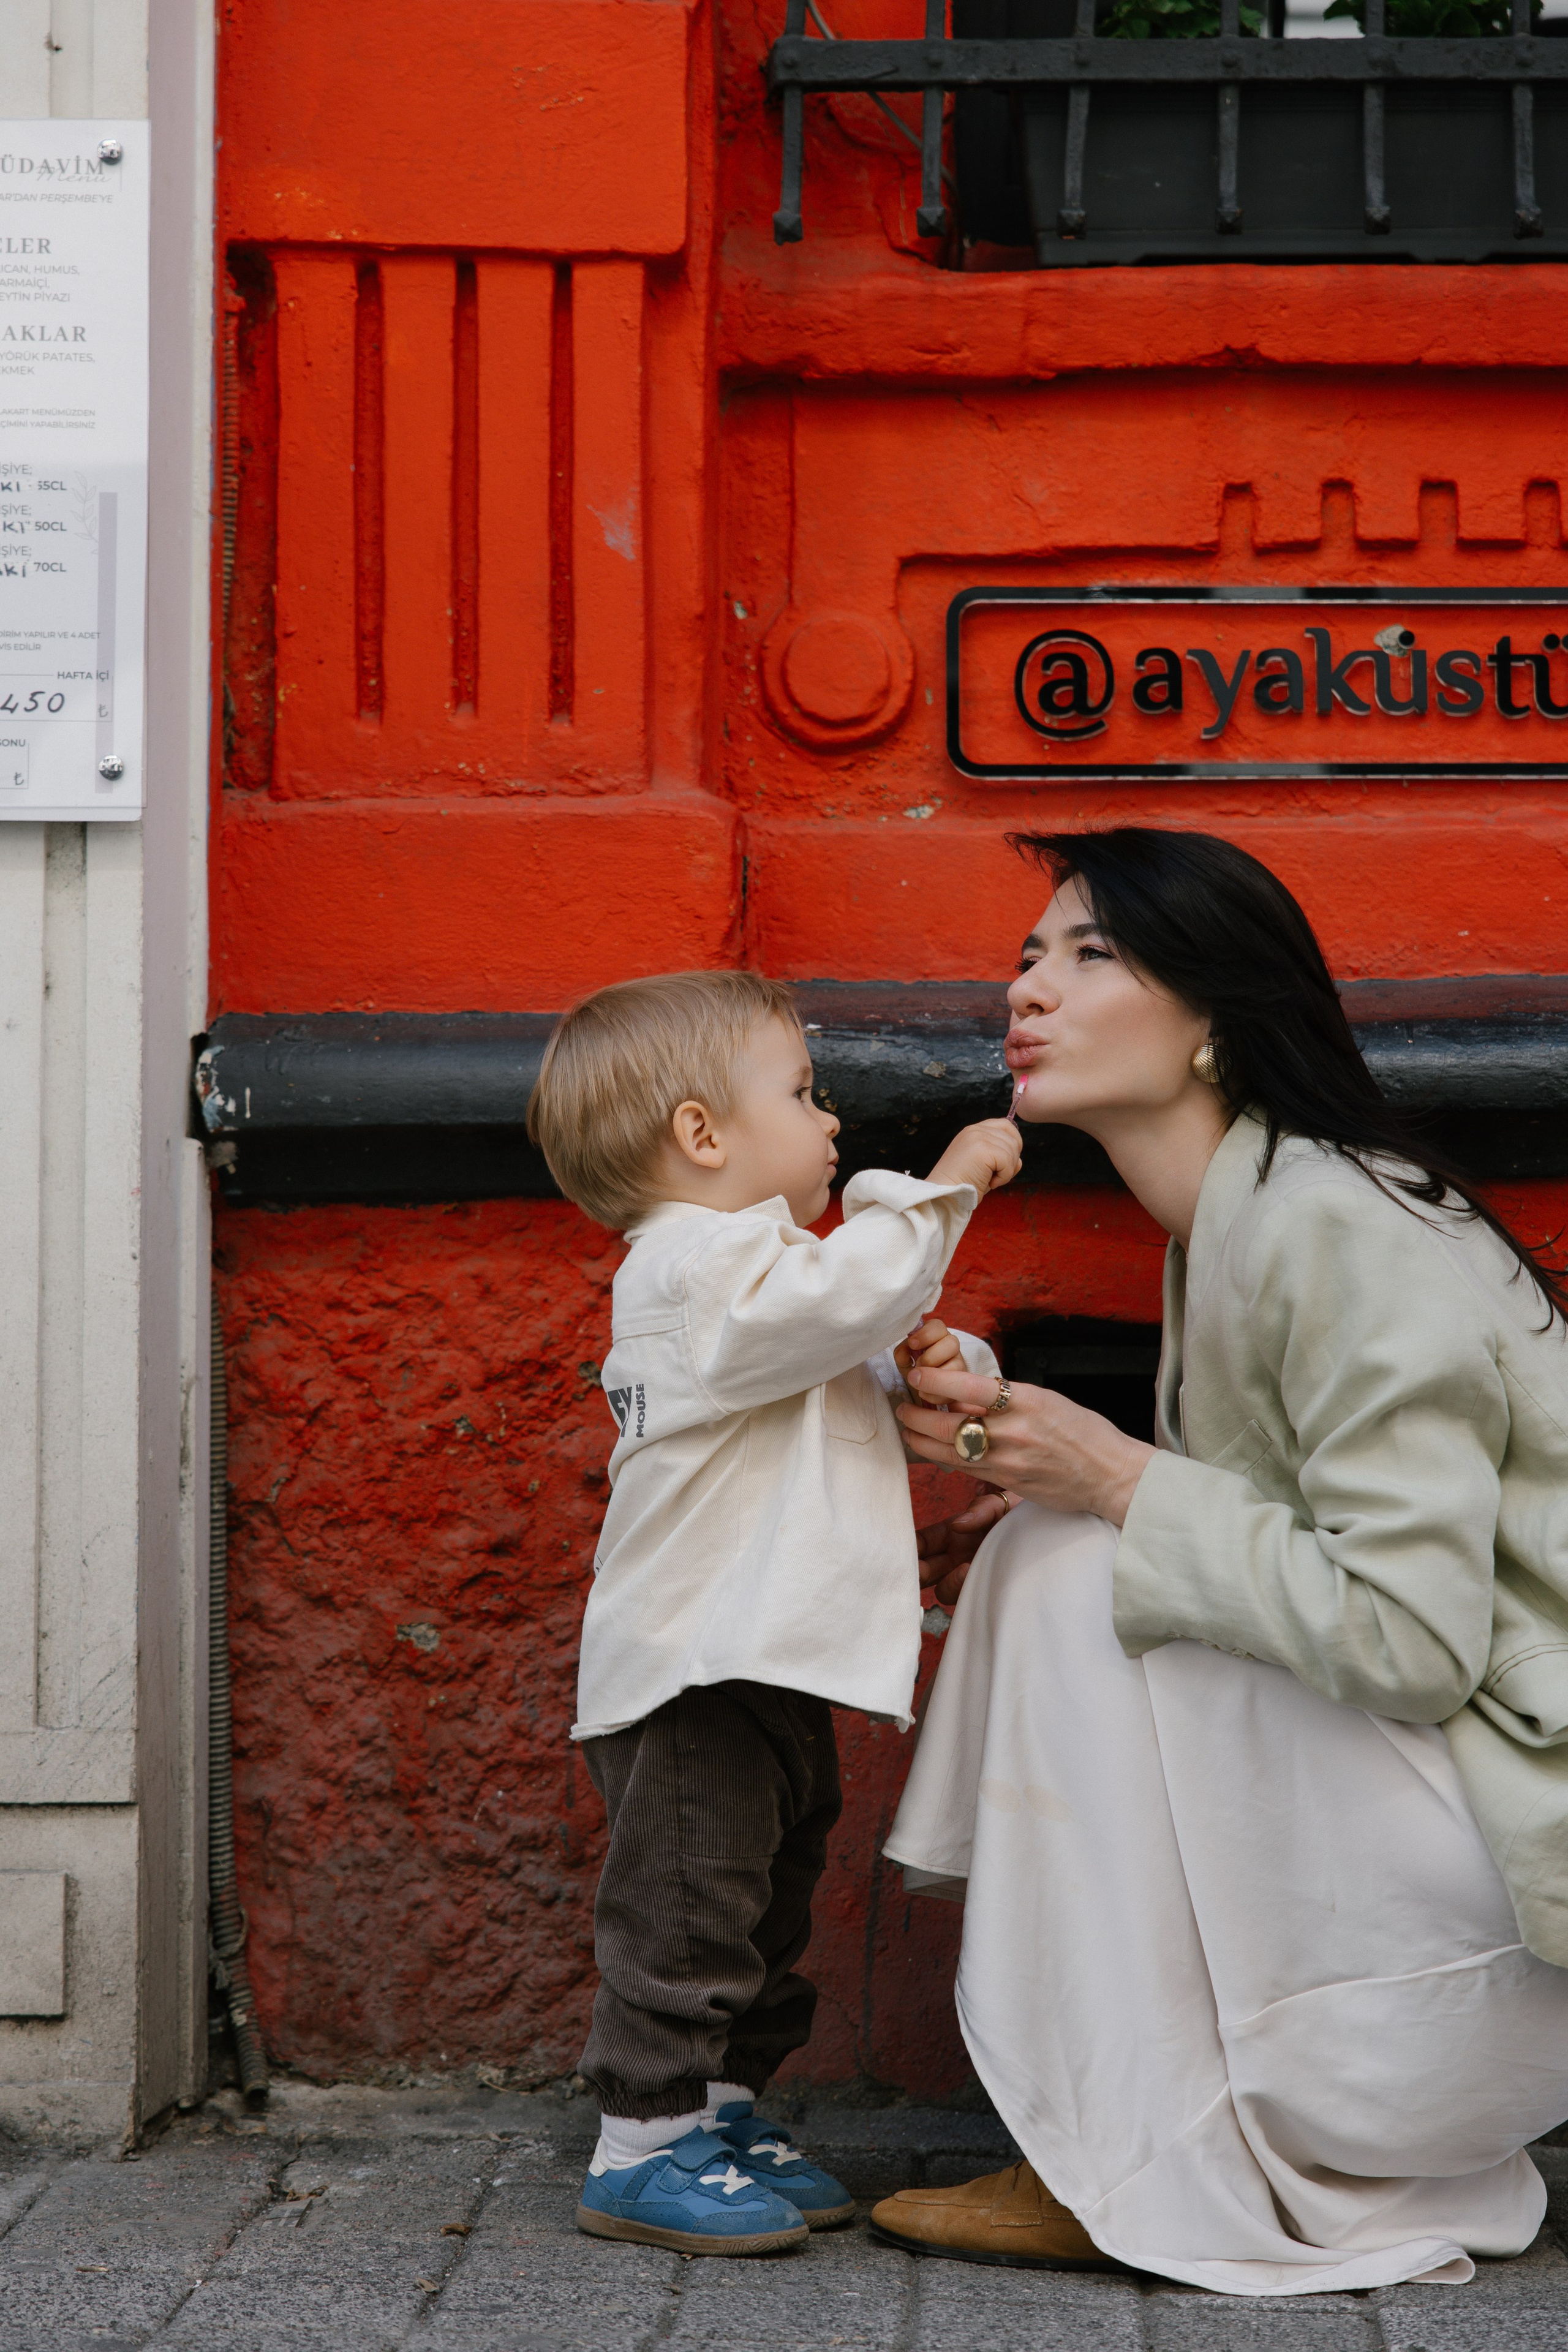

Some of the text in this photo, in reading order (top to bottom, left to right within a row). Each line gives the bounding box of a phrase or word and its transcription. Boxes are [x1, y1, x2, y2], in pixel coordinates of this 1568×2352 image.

[0, 237, 51, 254] LER
[34, 265, 80, 276] HUMUS,
[34, 291, 70, 303] PİYAZI
[1, 325, 87, 342] AKLAR
[43, 352, 96, 363] PATATES,
[0, 365, 35, 375] KMEK
[32, 407, 96, 417] MENÜMÜZDEN
[0, 462, 32, 477] ŞİYE;
[35, 521, 67, 531] 50CL
[34, 562, 67, 572] 70CL
[57, 669, 110, 682] HAFTA İÇİ
[635, 1383, 646, 1438] MOUSE
